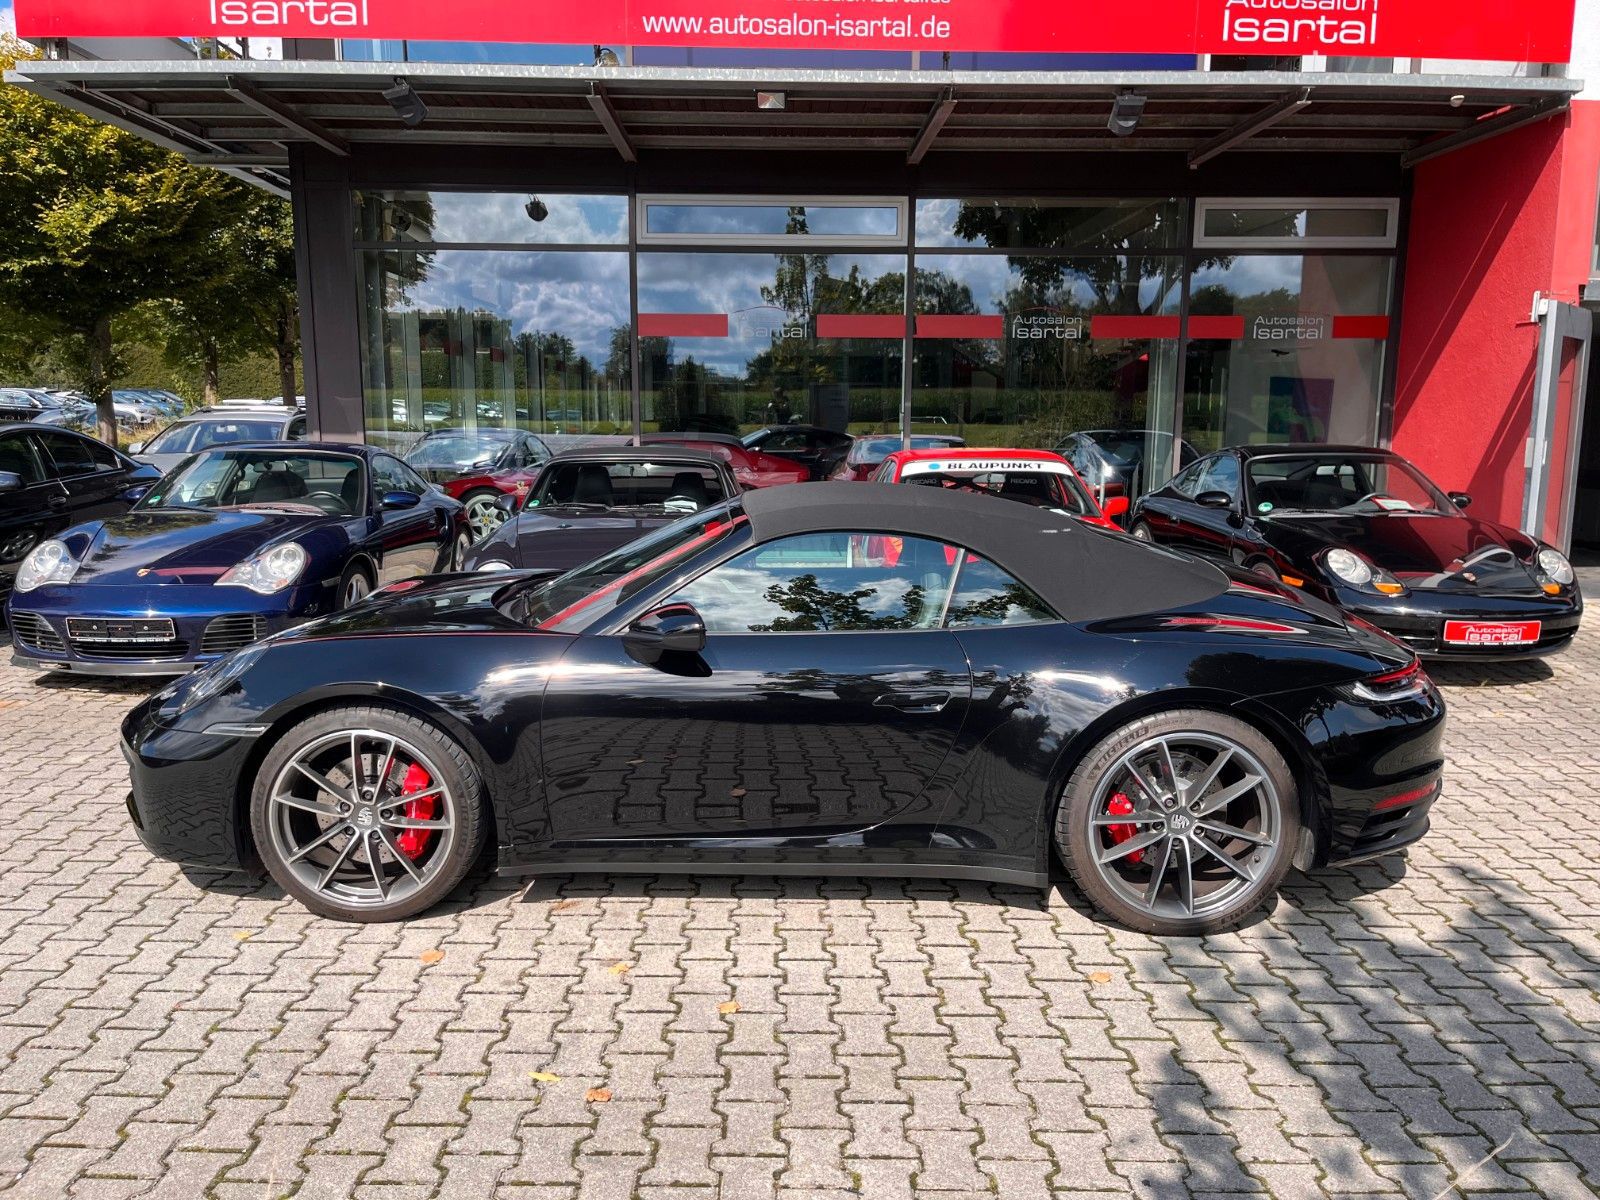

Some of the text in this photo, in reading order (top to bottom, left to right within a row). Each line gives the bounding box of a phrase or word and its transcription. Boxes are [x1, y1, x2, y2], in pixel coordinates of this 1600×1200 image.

[209, 0, 369, 26] Isartal
[642, 13, 951, 38] www.autosalon-isartal.de
[1222, 9, 1378, 45] Isartal
[1013, 315, 1083, 325] Autosalon
[1254, 315, 1324, 325] Autosalon
[740, 322, 808, 338] sartal
[1012, 324, 1082, 339] Isartal
[1252, 325, 1323, 339] Isartal
[947, 462, 1044, 470] BLAUPUNKT
[1467, 626, 1521, 634] Autosalon
